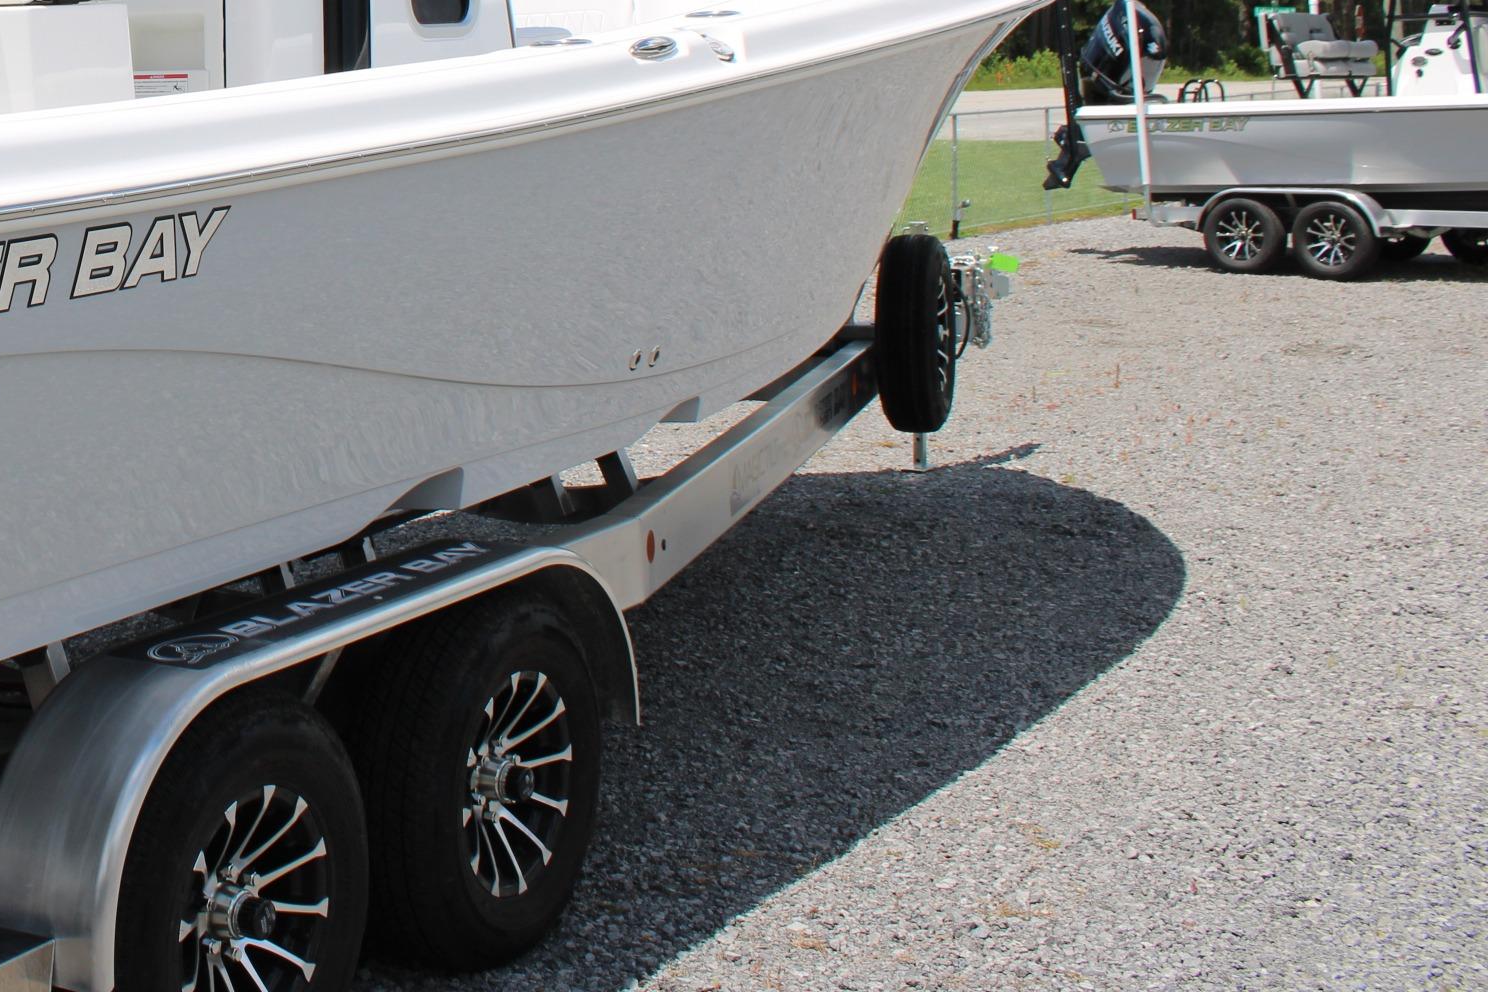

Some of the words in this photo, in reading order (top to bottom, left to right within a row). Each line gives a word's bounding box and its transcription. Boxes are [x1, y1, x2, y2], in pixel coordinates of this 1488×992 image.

[1209, 115, 1250, 132] BAY
[69, 205, 232, 300] BAY
[219, 570, 415, 638] BLAZER
[400, 541, 489, 573] BAY
